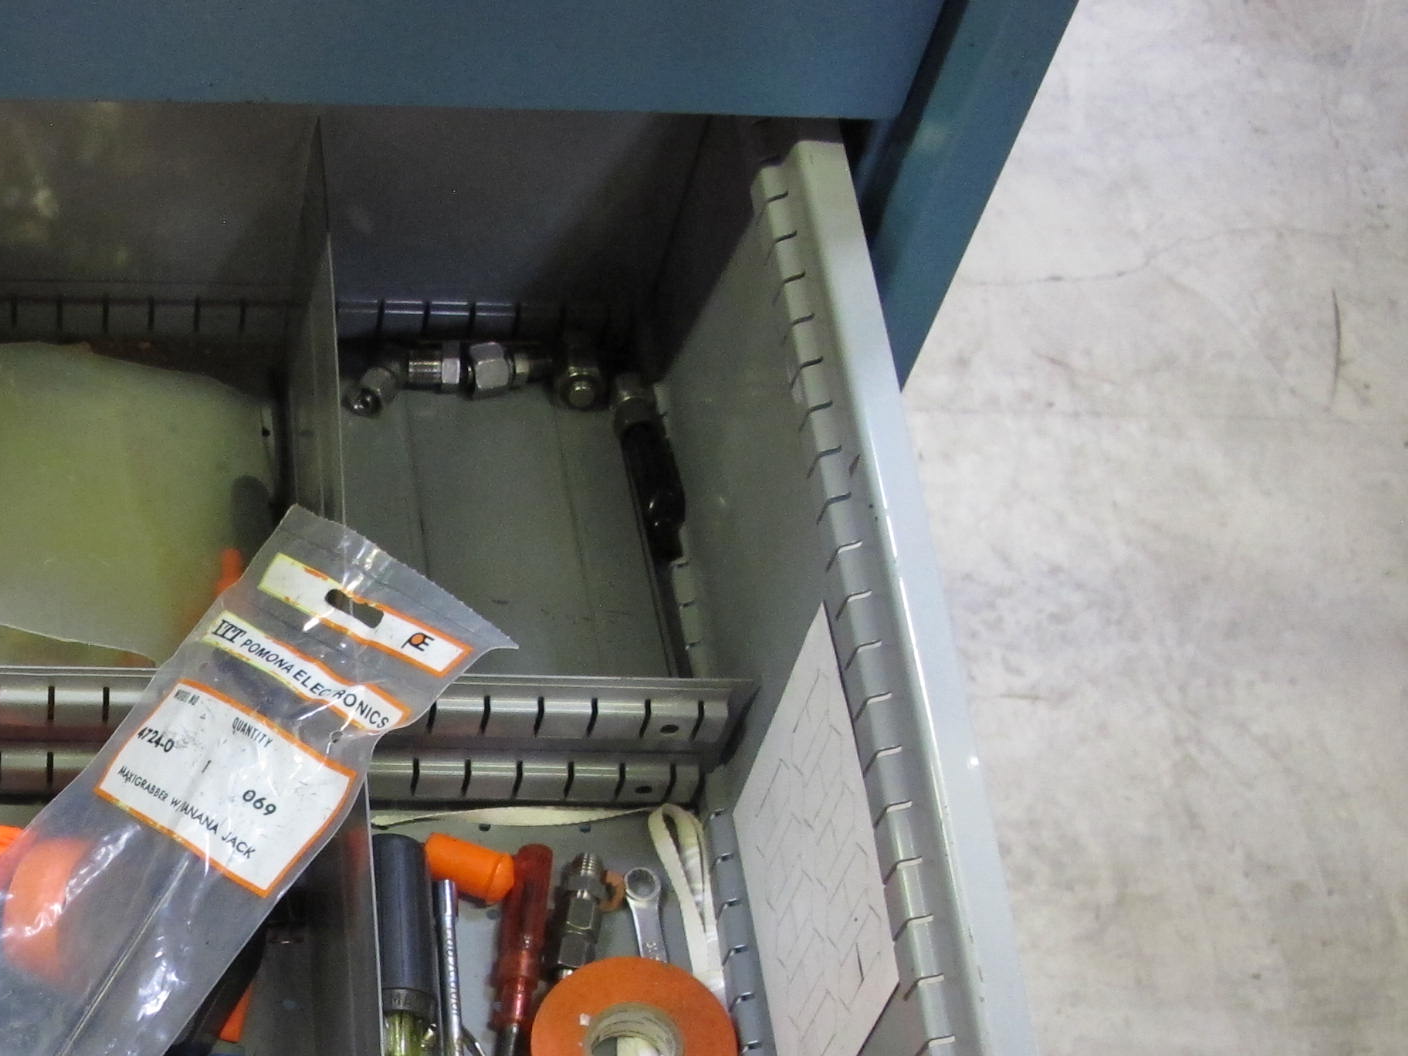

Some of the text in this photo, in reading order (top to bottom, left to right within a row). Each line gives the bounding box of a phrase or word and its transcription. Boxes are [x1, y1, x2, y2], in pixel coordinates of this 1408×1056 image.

[211, 618, 390, 729] ITT POMONA ELECRONICS
[137, 726, 175, 753] 4724-0
[231, 716, 273, 748] QUANTITY
[118, 765, 169, 802] MAXIGRABBER
[221, 831, 256, 859] JACK
[242, 789, 277, 817] 069
